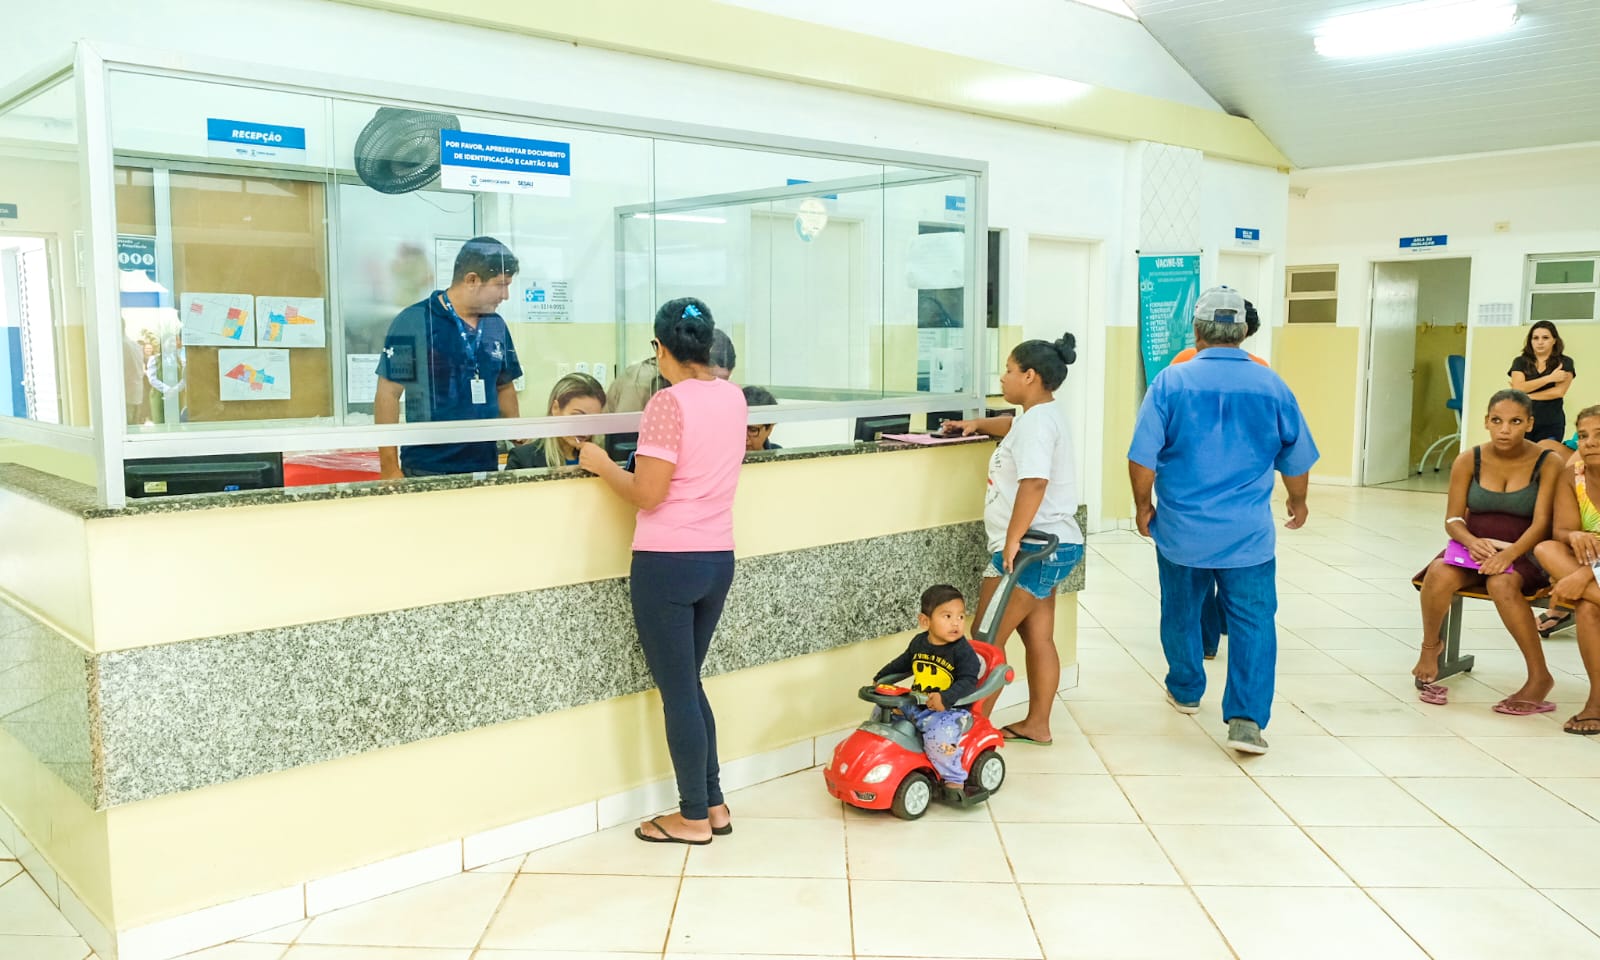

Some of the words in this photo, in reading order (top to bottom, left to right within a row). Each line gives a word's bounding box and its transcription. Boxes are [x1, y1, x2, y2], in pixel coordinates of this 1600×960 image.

[232, 129, 282, 143] RECEPÇÃO
[445, 140, 460, 148] POR
[461, 142, 484, 151] FAVOR,
[485, 145, 526, 155] APRESENTAR
[527, 149, 566, 158] DOCUMENTO
[464, 154, 514, 165] IDENTIFICAÇÃO
[520, 158, 546, 167] CARTÃO
